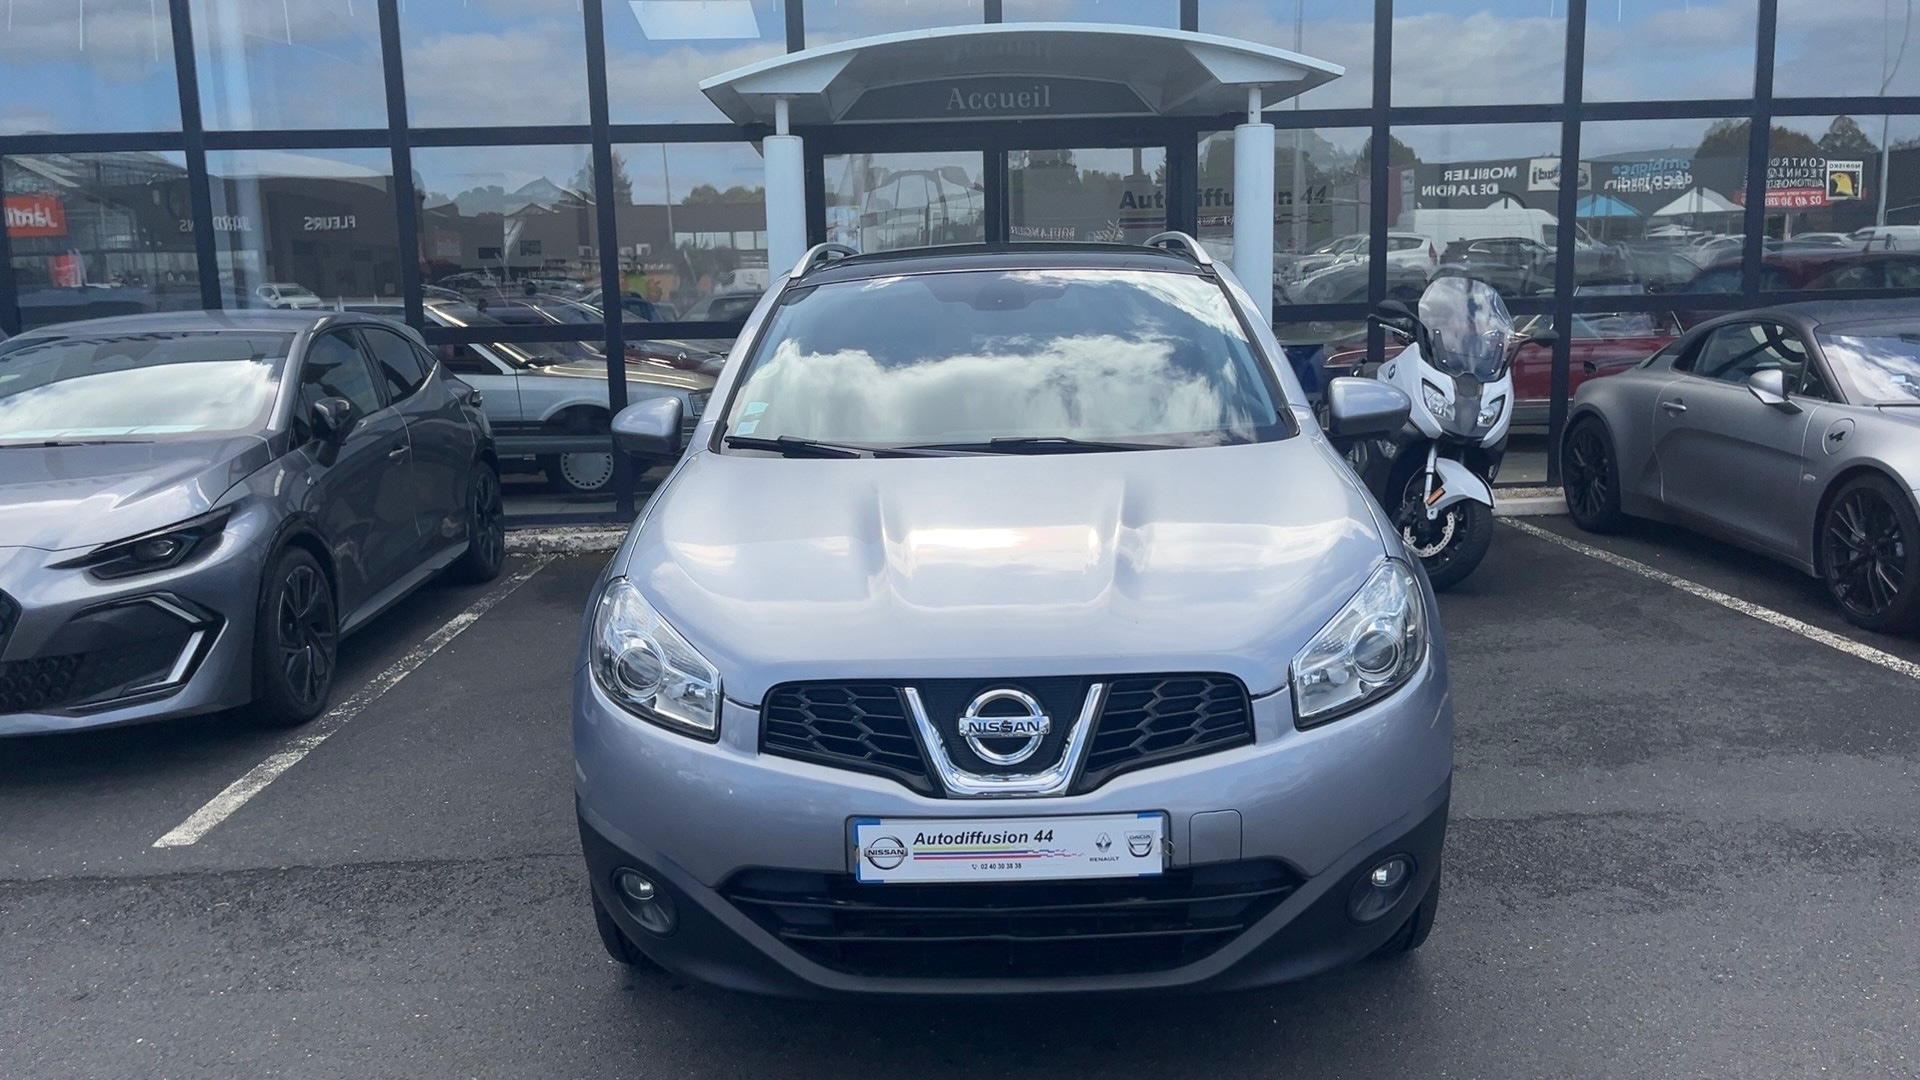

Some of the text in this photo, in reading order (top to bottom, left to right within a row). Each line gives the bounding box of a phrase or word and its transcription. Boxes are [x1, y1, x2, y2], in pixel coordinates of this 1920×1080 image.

[946, 85, 1051, 110] Accueil
[968, 720, 1040, 733] NISSAN
[913, 829, 1054, 846] Autodiffusion 44
